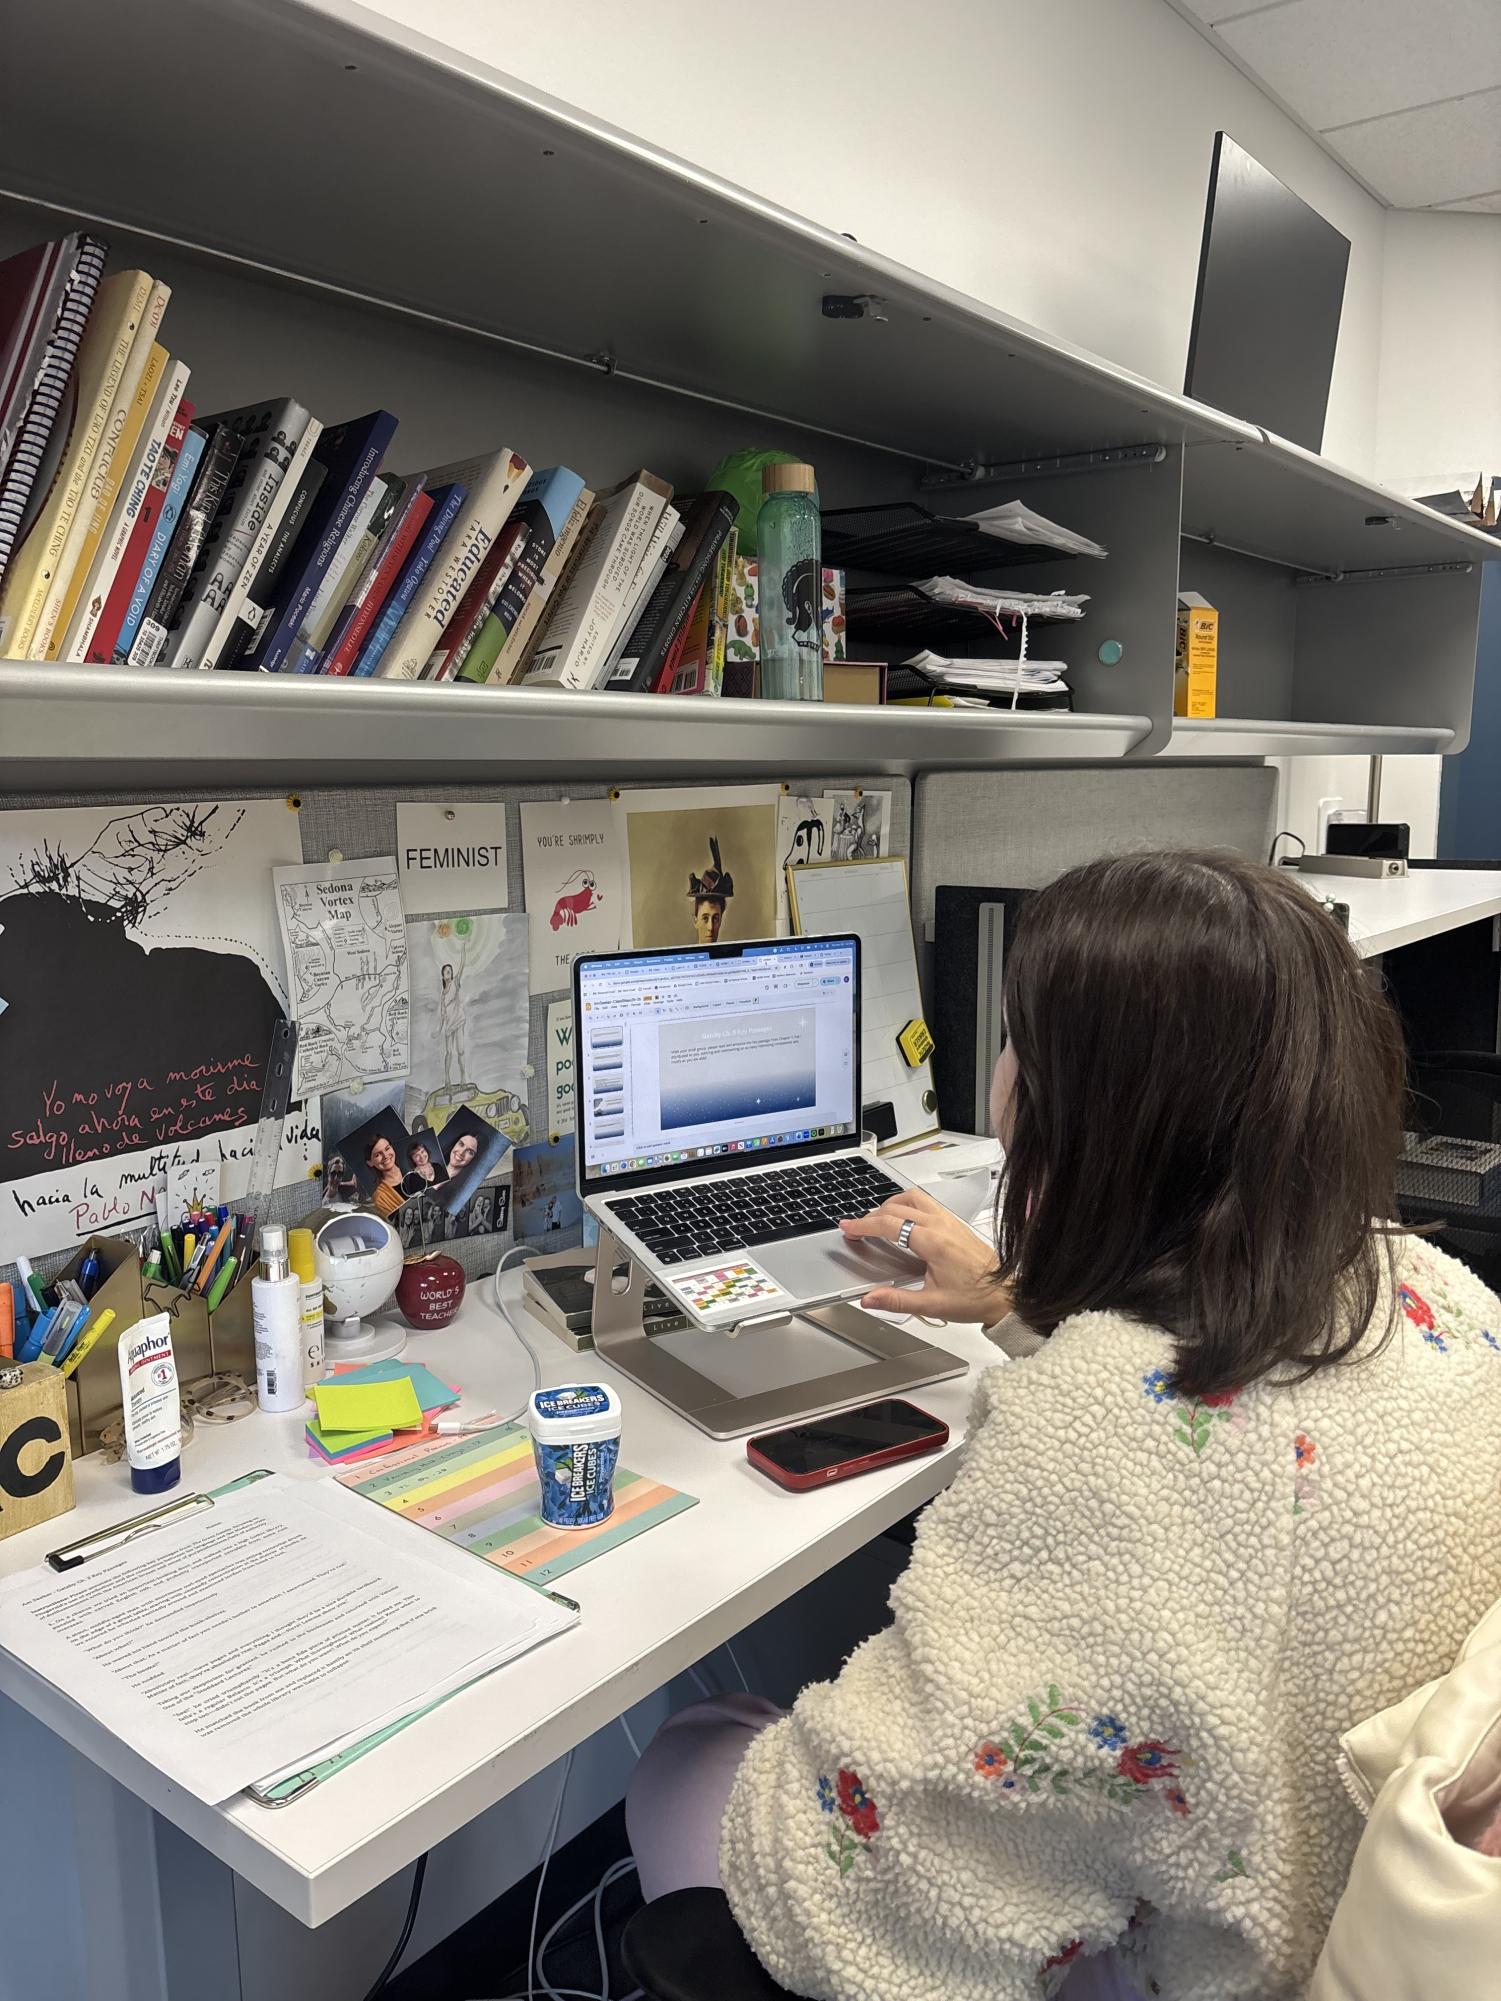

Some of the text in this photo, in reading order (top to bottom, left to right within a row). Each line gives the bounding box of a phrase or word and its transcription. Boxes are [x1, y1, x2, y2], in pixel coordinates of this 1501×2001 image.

[118, 337, 130, 356] THE
[105, 356, 124, 398] LEGEND
[99, 398, 109, 413] OF
[90, 409, 127, 500] CONFUCIUS
[126, 438, 162, 519] TAO TE CHING
[171, 453, 194, 497] Emi Yagi
[62, 509, 72, 524] TE
[247, 474, 280, 531] Inside
[317, 447, 379, 567] Introducing Chinese Religions
[268, 489, 308, 574] CONFUCIUS THE ANALECTS
[427, 493, 463, 552] The Diving Pool
[555, 499, 587, 558] El feliz ingenio
[49, 525, 65, 558] CHING
[147, 531, 166, 567] DIARY
[255, 532, 272, 556] YEAR
[140, 567, 154, 585] OF
[250, 556, 259, 570] OF
[401, 555, 430, 600] Yoko Ogawa
[425, 519, 480, 620] TARA WESTOVER
[433, 527, 492, 629] Educated
[137, 586, 146, 594] A
[241, 569, 254, 590] ZEN
[127, 597, 146, 627] VOID
[537, 833, 604, 848] YOU'RE SHRIMPLY
[406, 846, 502, 870] FEMINIST
[316, 882, 354, 895] Sedona
[320, 895, 354, 908] Vortex
[328, 910, 352, 921] Map
[555, 953, 570, 966] THE
[79, 1109, 143, 1136] ahora
[156, 1105, 249, 1138] volcanes
[13, 1189, 73, 1218] hacia
[83, 1177, 104, 1199] la
[69, 1196, 132, 1231] Pablo
[420, 1286, 459, 1300] WORLD'S
[429, 1300, 453, 1311] BEST
[540, 1394, 605, 1409] ICE BREAKERS
[566, 1401, 600, 1410] CUBES
[0, 1416, 65, 1498] C
[586, 1448, 597, 1494] ICE CUBES
[570, 1444, 589, 1502] ICE BREAKERS
